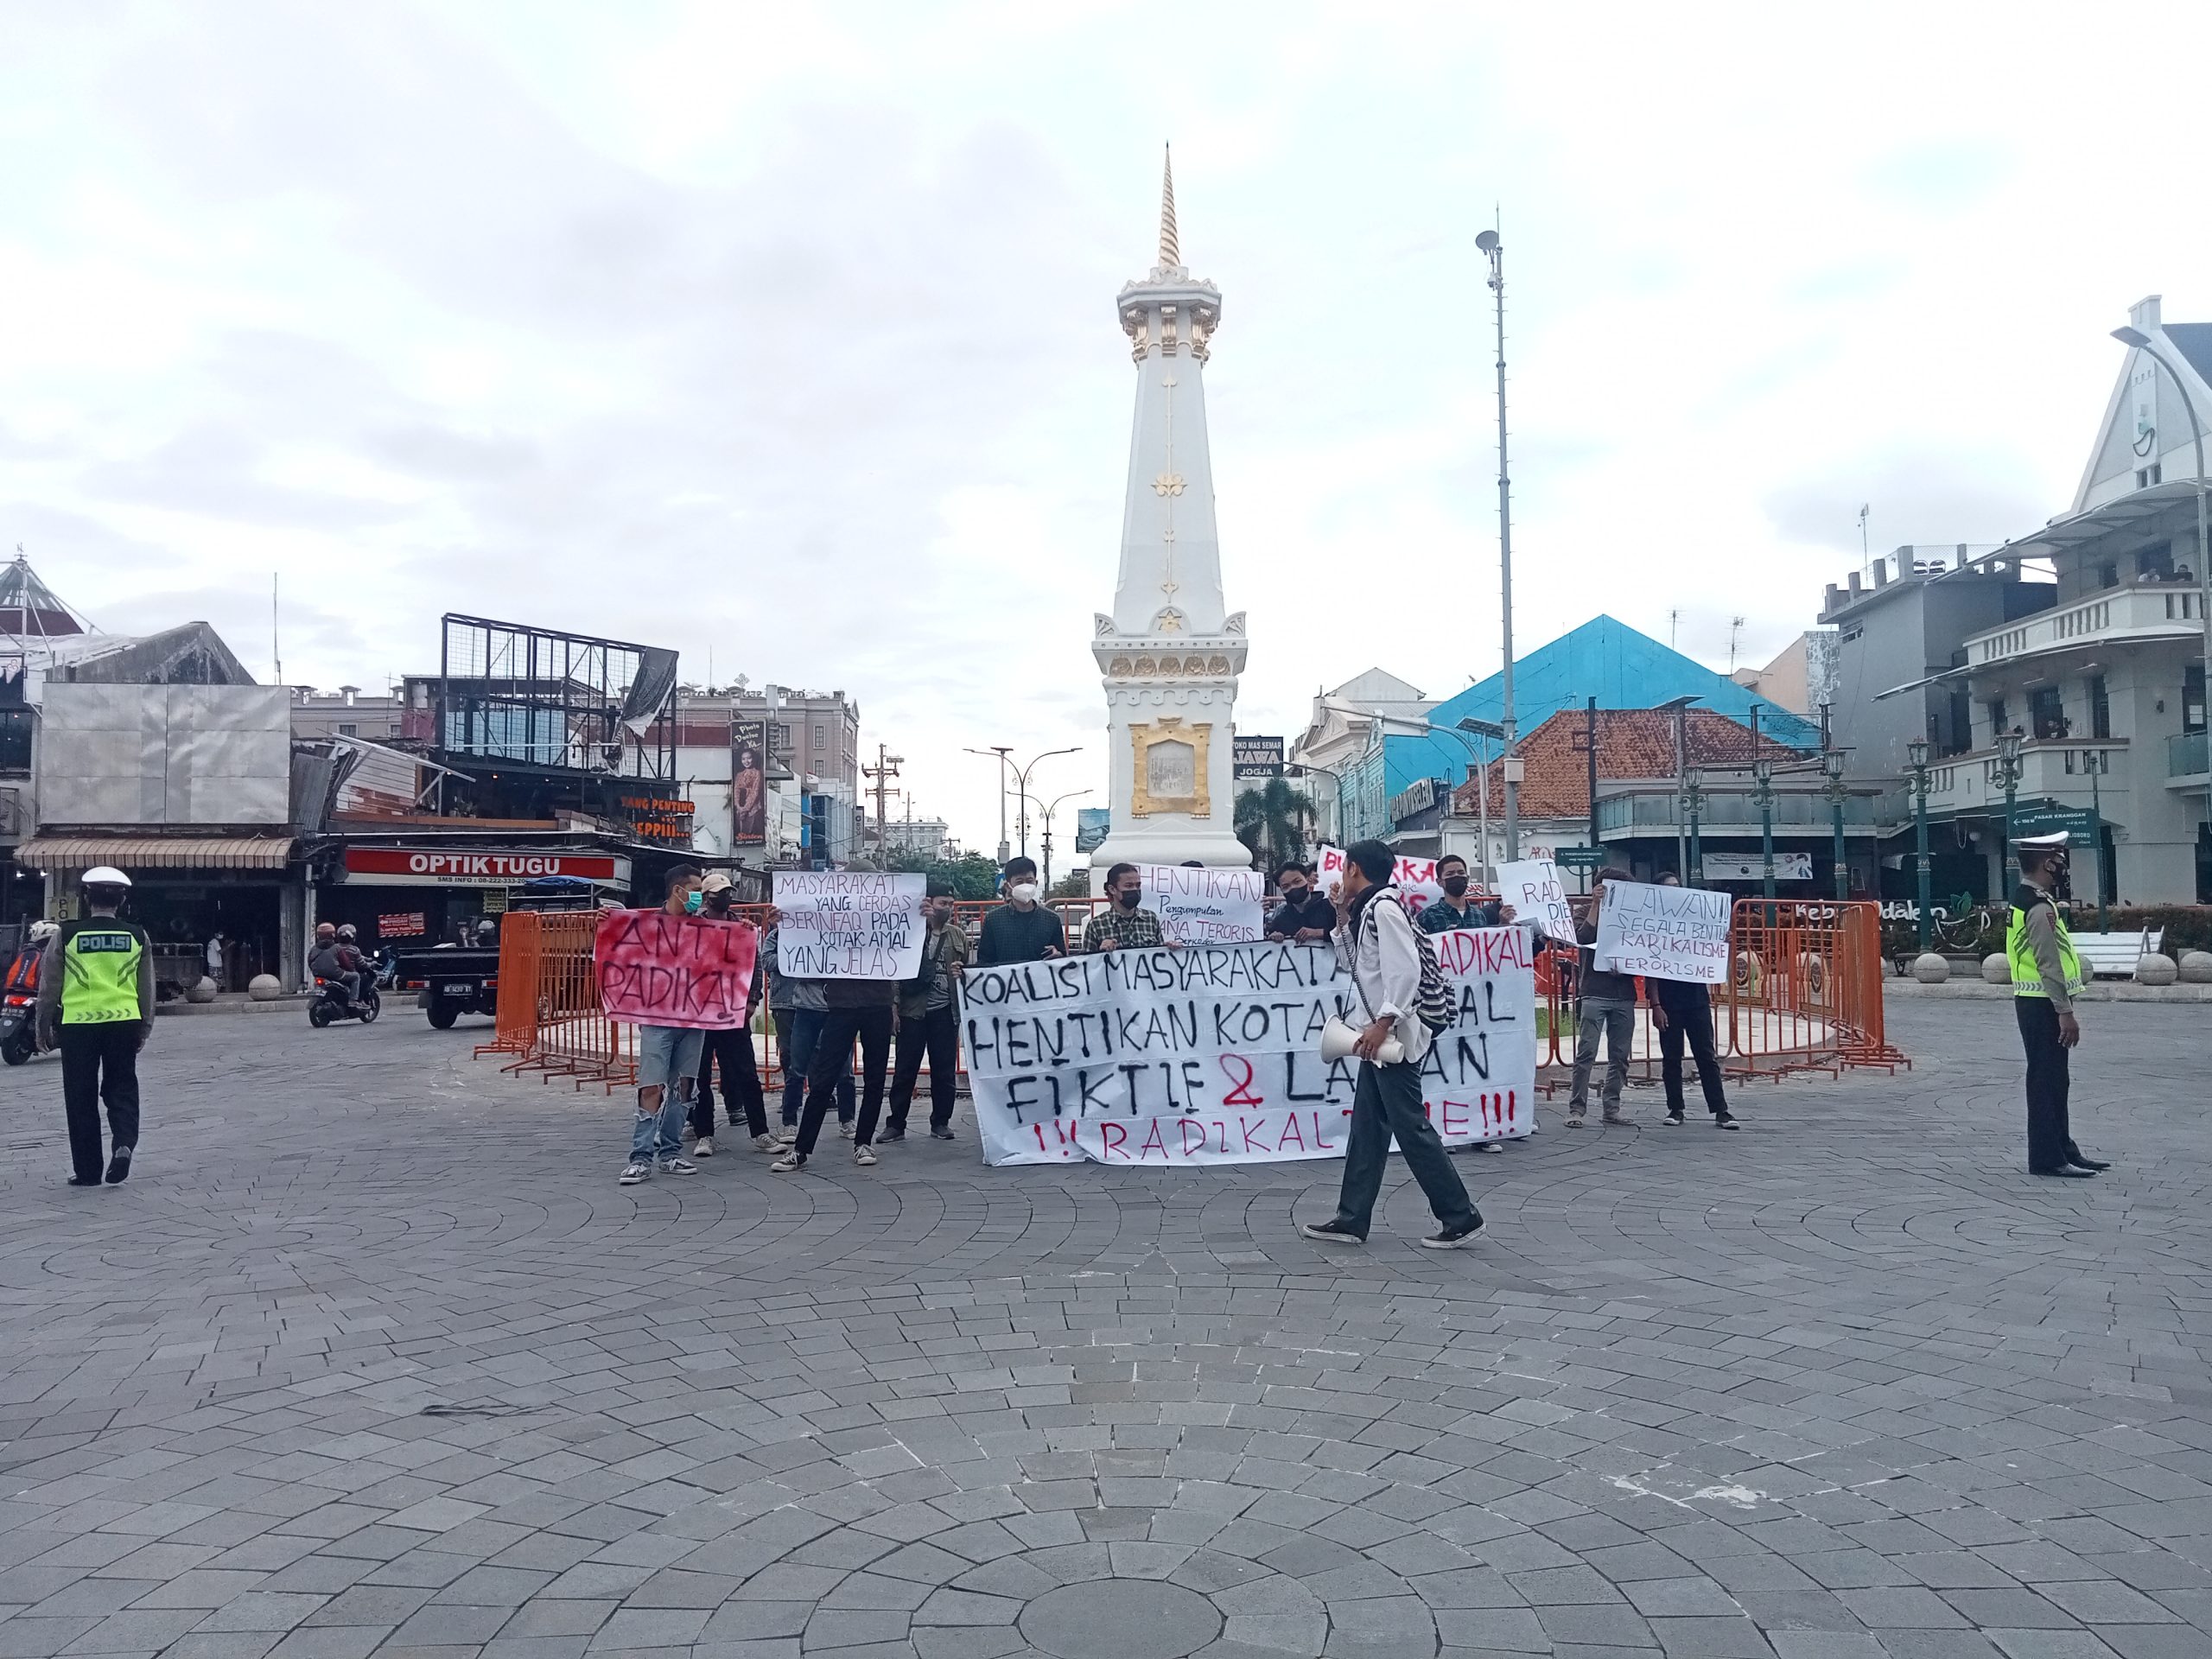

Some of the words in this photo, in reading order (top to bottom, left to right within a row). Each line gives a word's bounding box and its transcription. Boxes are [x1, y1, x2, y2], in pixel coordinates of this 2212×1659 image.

[1233, 751, 1280, 765] JAWA
[652, 799, 695, 812] PENTING
[410, 854, 489, 874] OPTIK
[489, 856, 560, 875] TUGU
[778, 874, 902, 895] MASYARAKAT
[1135, 865, 1262, 903] HENTIKAN
[815, 896, 851, 912] YANG
[858, 895, 912, 913] CERDAS
[1159, 895, 1224, 922] Pengumpulan
[780, 912, 862, 931] BERINFAQ
[871, 912, 911, 931] PADA
[1160, 920, 1191, 938] ANA
[1196, 920, 1255, 943] TERORIS
[1606, 912, 1686, 935] SEGALA
[1691, 922, 1726, 941] BENTU
[79, 936, 130, 950] POLISI
[611, 918, 736, 963] ANTI
[815, 931, 866, 947] KOTAK
[868, 931, 912, 949] AMAL
[1622, 931, 1726, 958] RADIKALISME
[784, 945, 838, 974] YANG
[841, 947, 898, 976] JELAS
[961, 960, 1091, 1009] KOALISI
[1103, 949, 1325, 991] MASYARAKAT
[1440, 929, 1533, 976] ADIKAL
[1607, 956, 1715, 978] TERORISME
[602, 960, 746, 1018] RADIKAL
[969, 1000, 1198, 1070] HENTIKAN
[1007, 1062, 1205, 1124] FIKTIF
